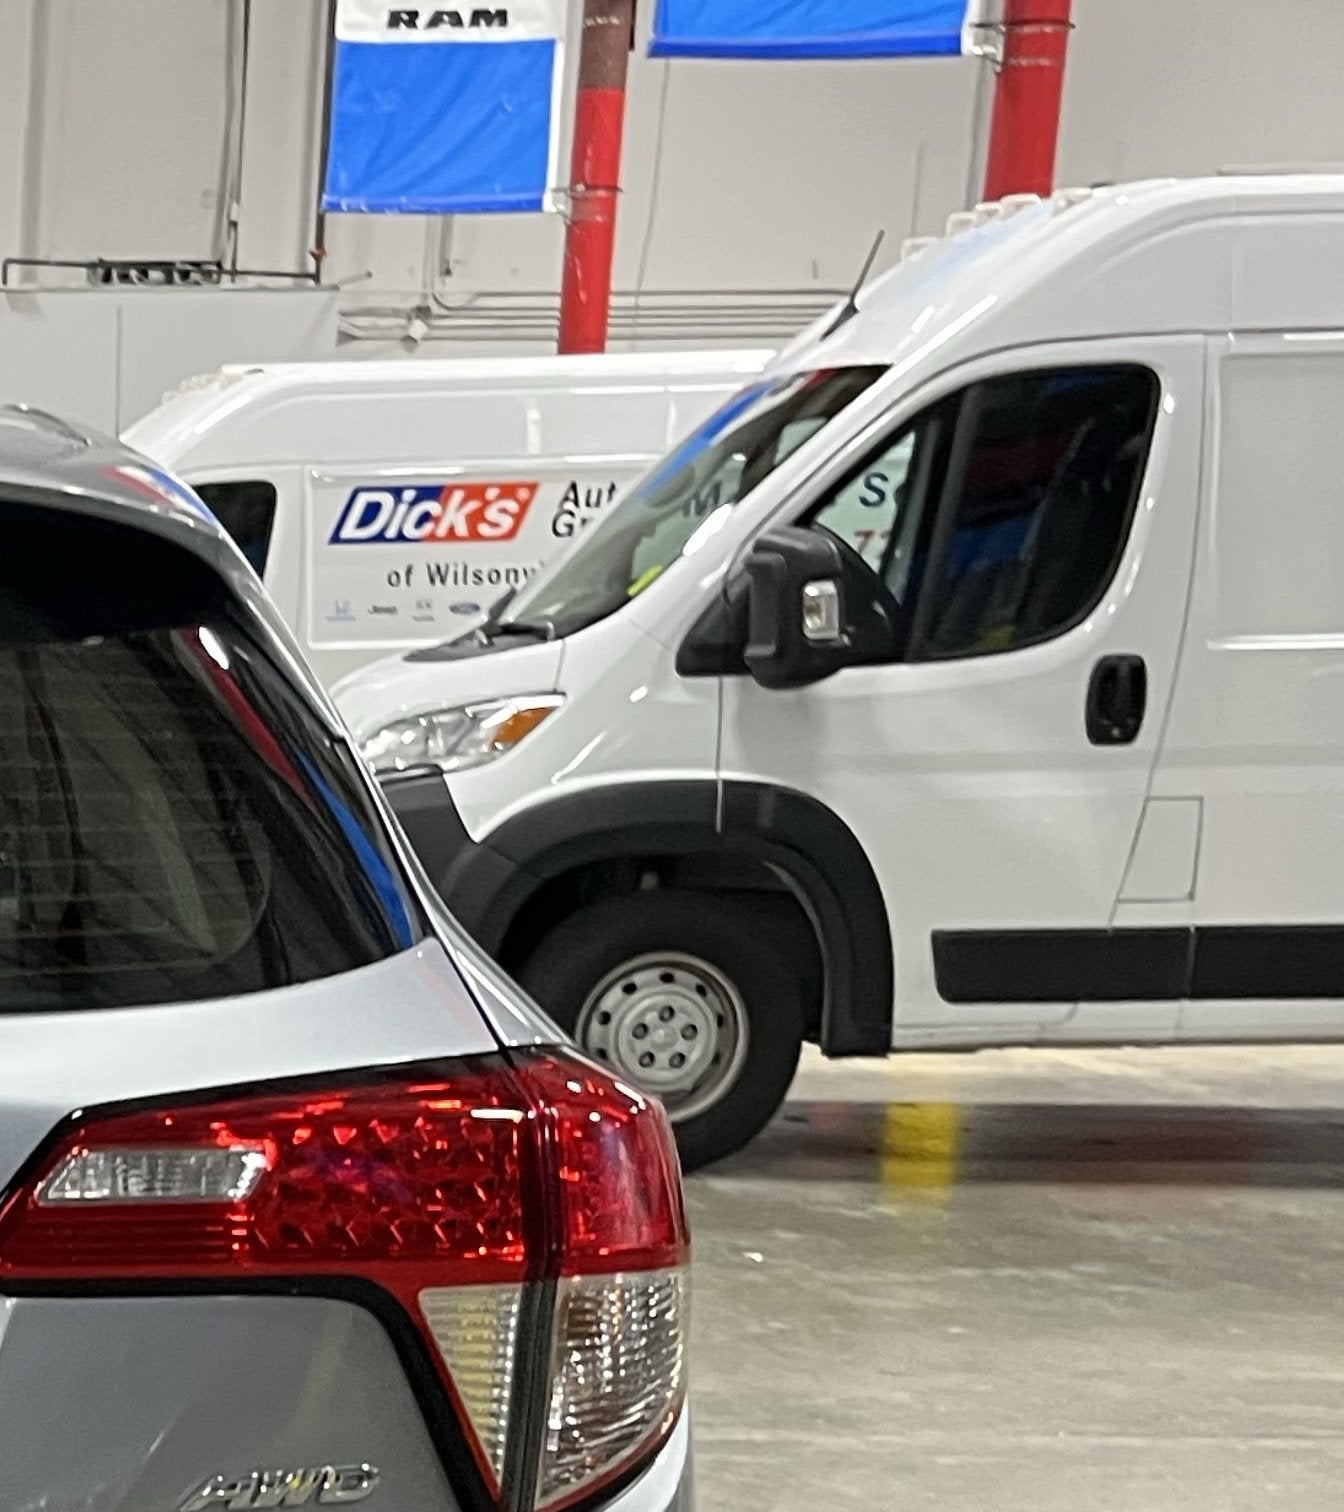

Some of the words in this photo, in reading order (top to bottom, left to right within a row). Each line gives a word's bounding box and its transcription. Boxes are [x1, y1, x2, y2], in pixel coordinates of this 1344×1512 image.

[386, 8, 508, 29] RAM
[562, 480, 617, 510] Aut
[338, 486, 520, 540] Dick's
[387, 563, 415, 588] of
